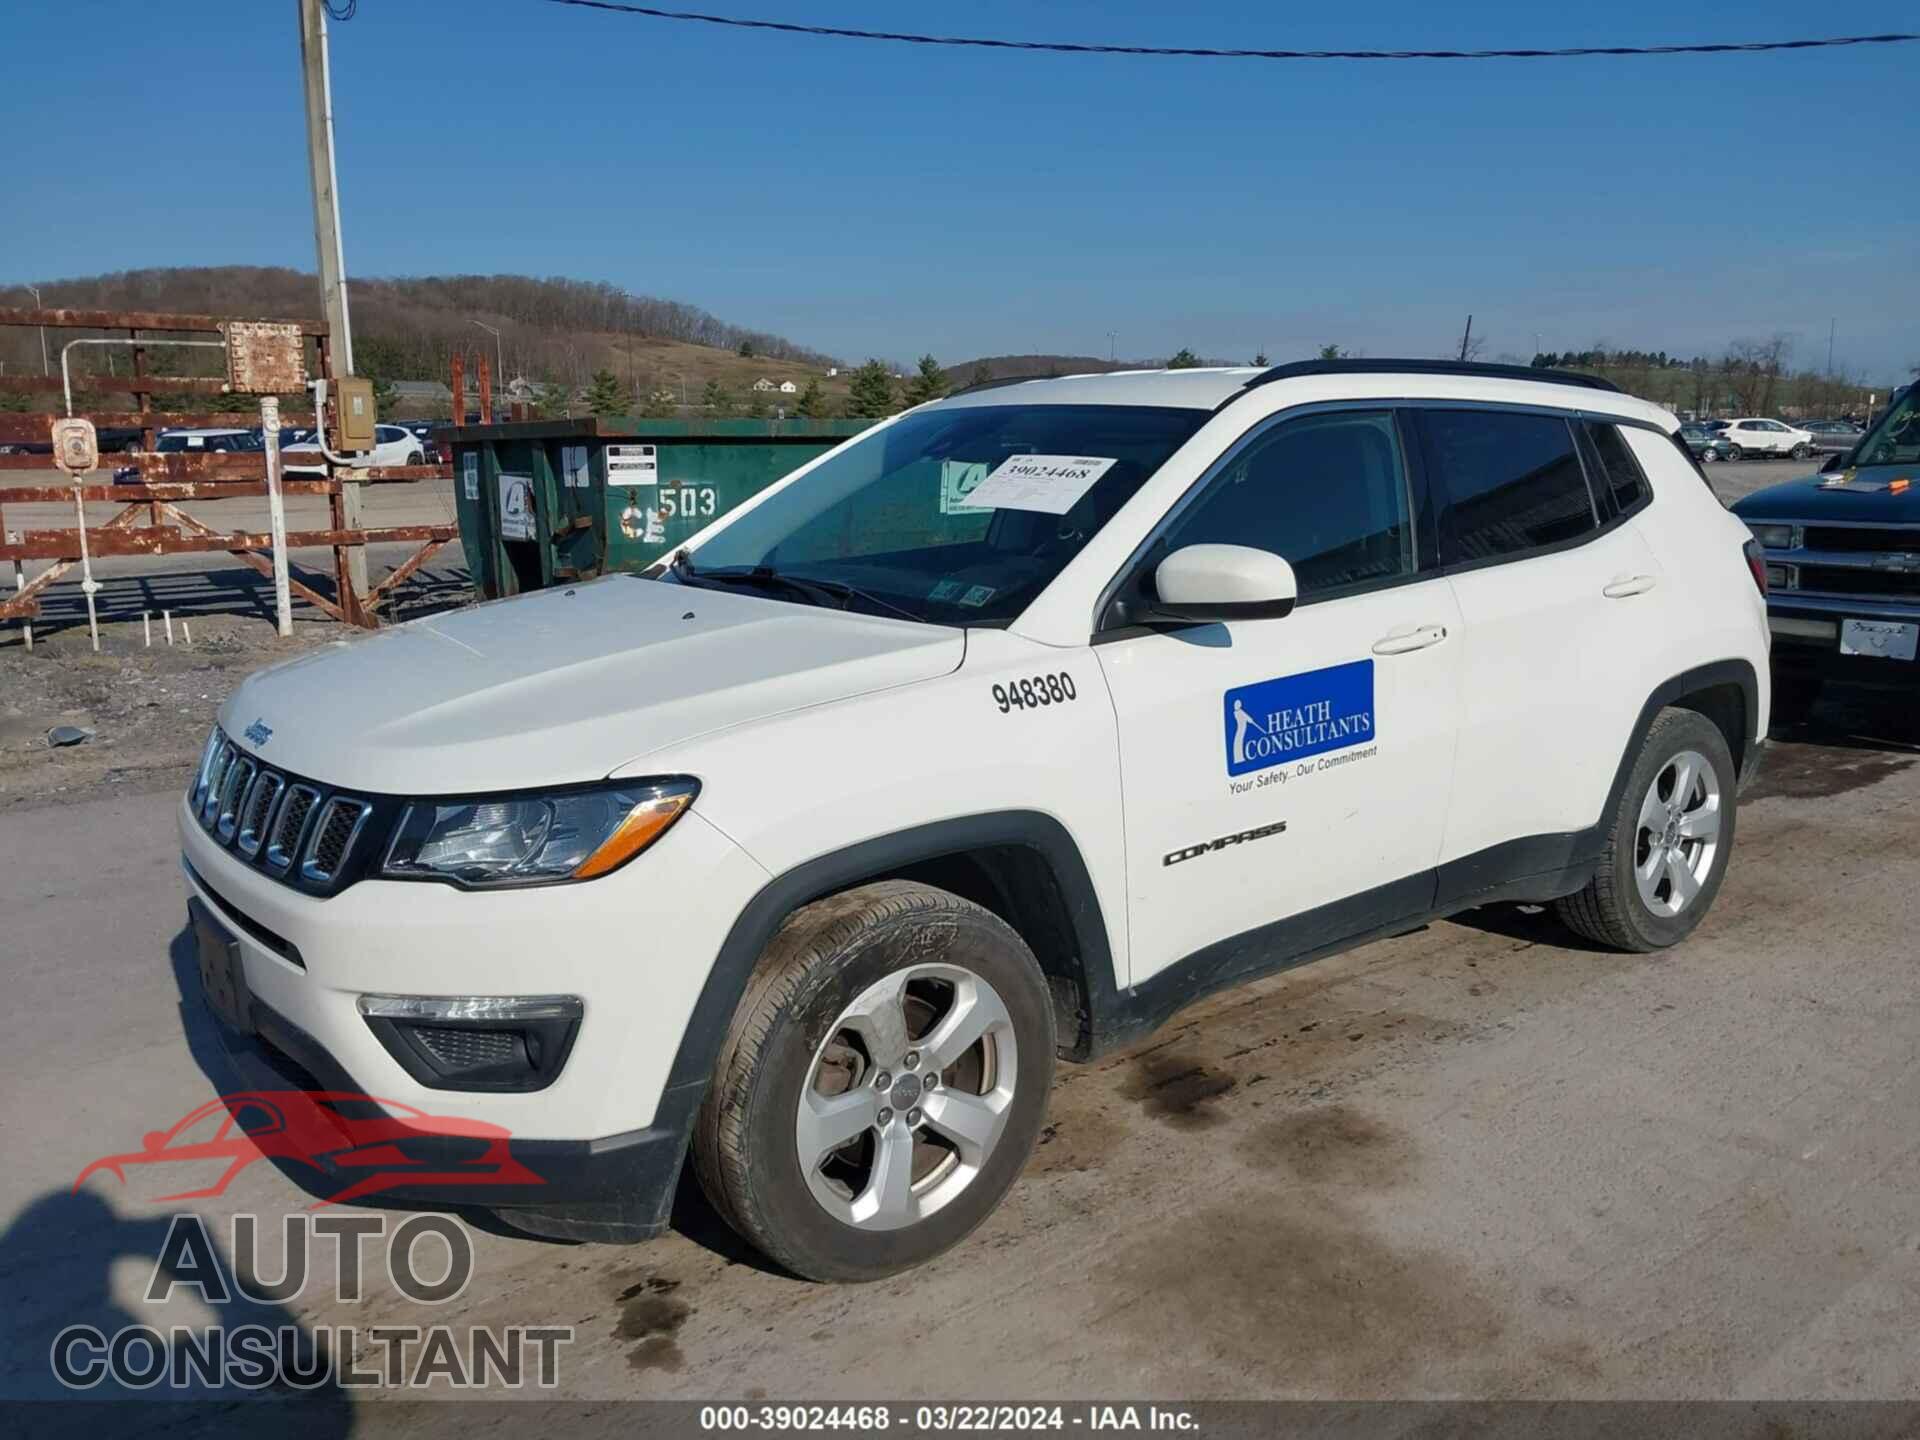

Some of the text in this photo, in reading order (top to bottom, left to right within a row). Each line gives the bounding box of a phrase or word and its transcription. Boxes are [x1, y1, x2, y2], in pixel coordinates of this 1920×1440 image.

[1009, 465, 1091, 480] 39024468
[659, 488, 716, 517] 503
[992, 671, 1077, 714] 948380
[1245, 712, 1371, 761] CONSULTANTS
[1267, 700, 1331, 735] HEATH
[1229, 778, 1254, 795] Your
[1317, 746, 1378, 772] Commitment
[1163, 820, 1287, 867] COMPASS
